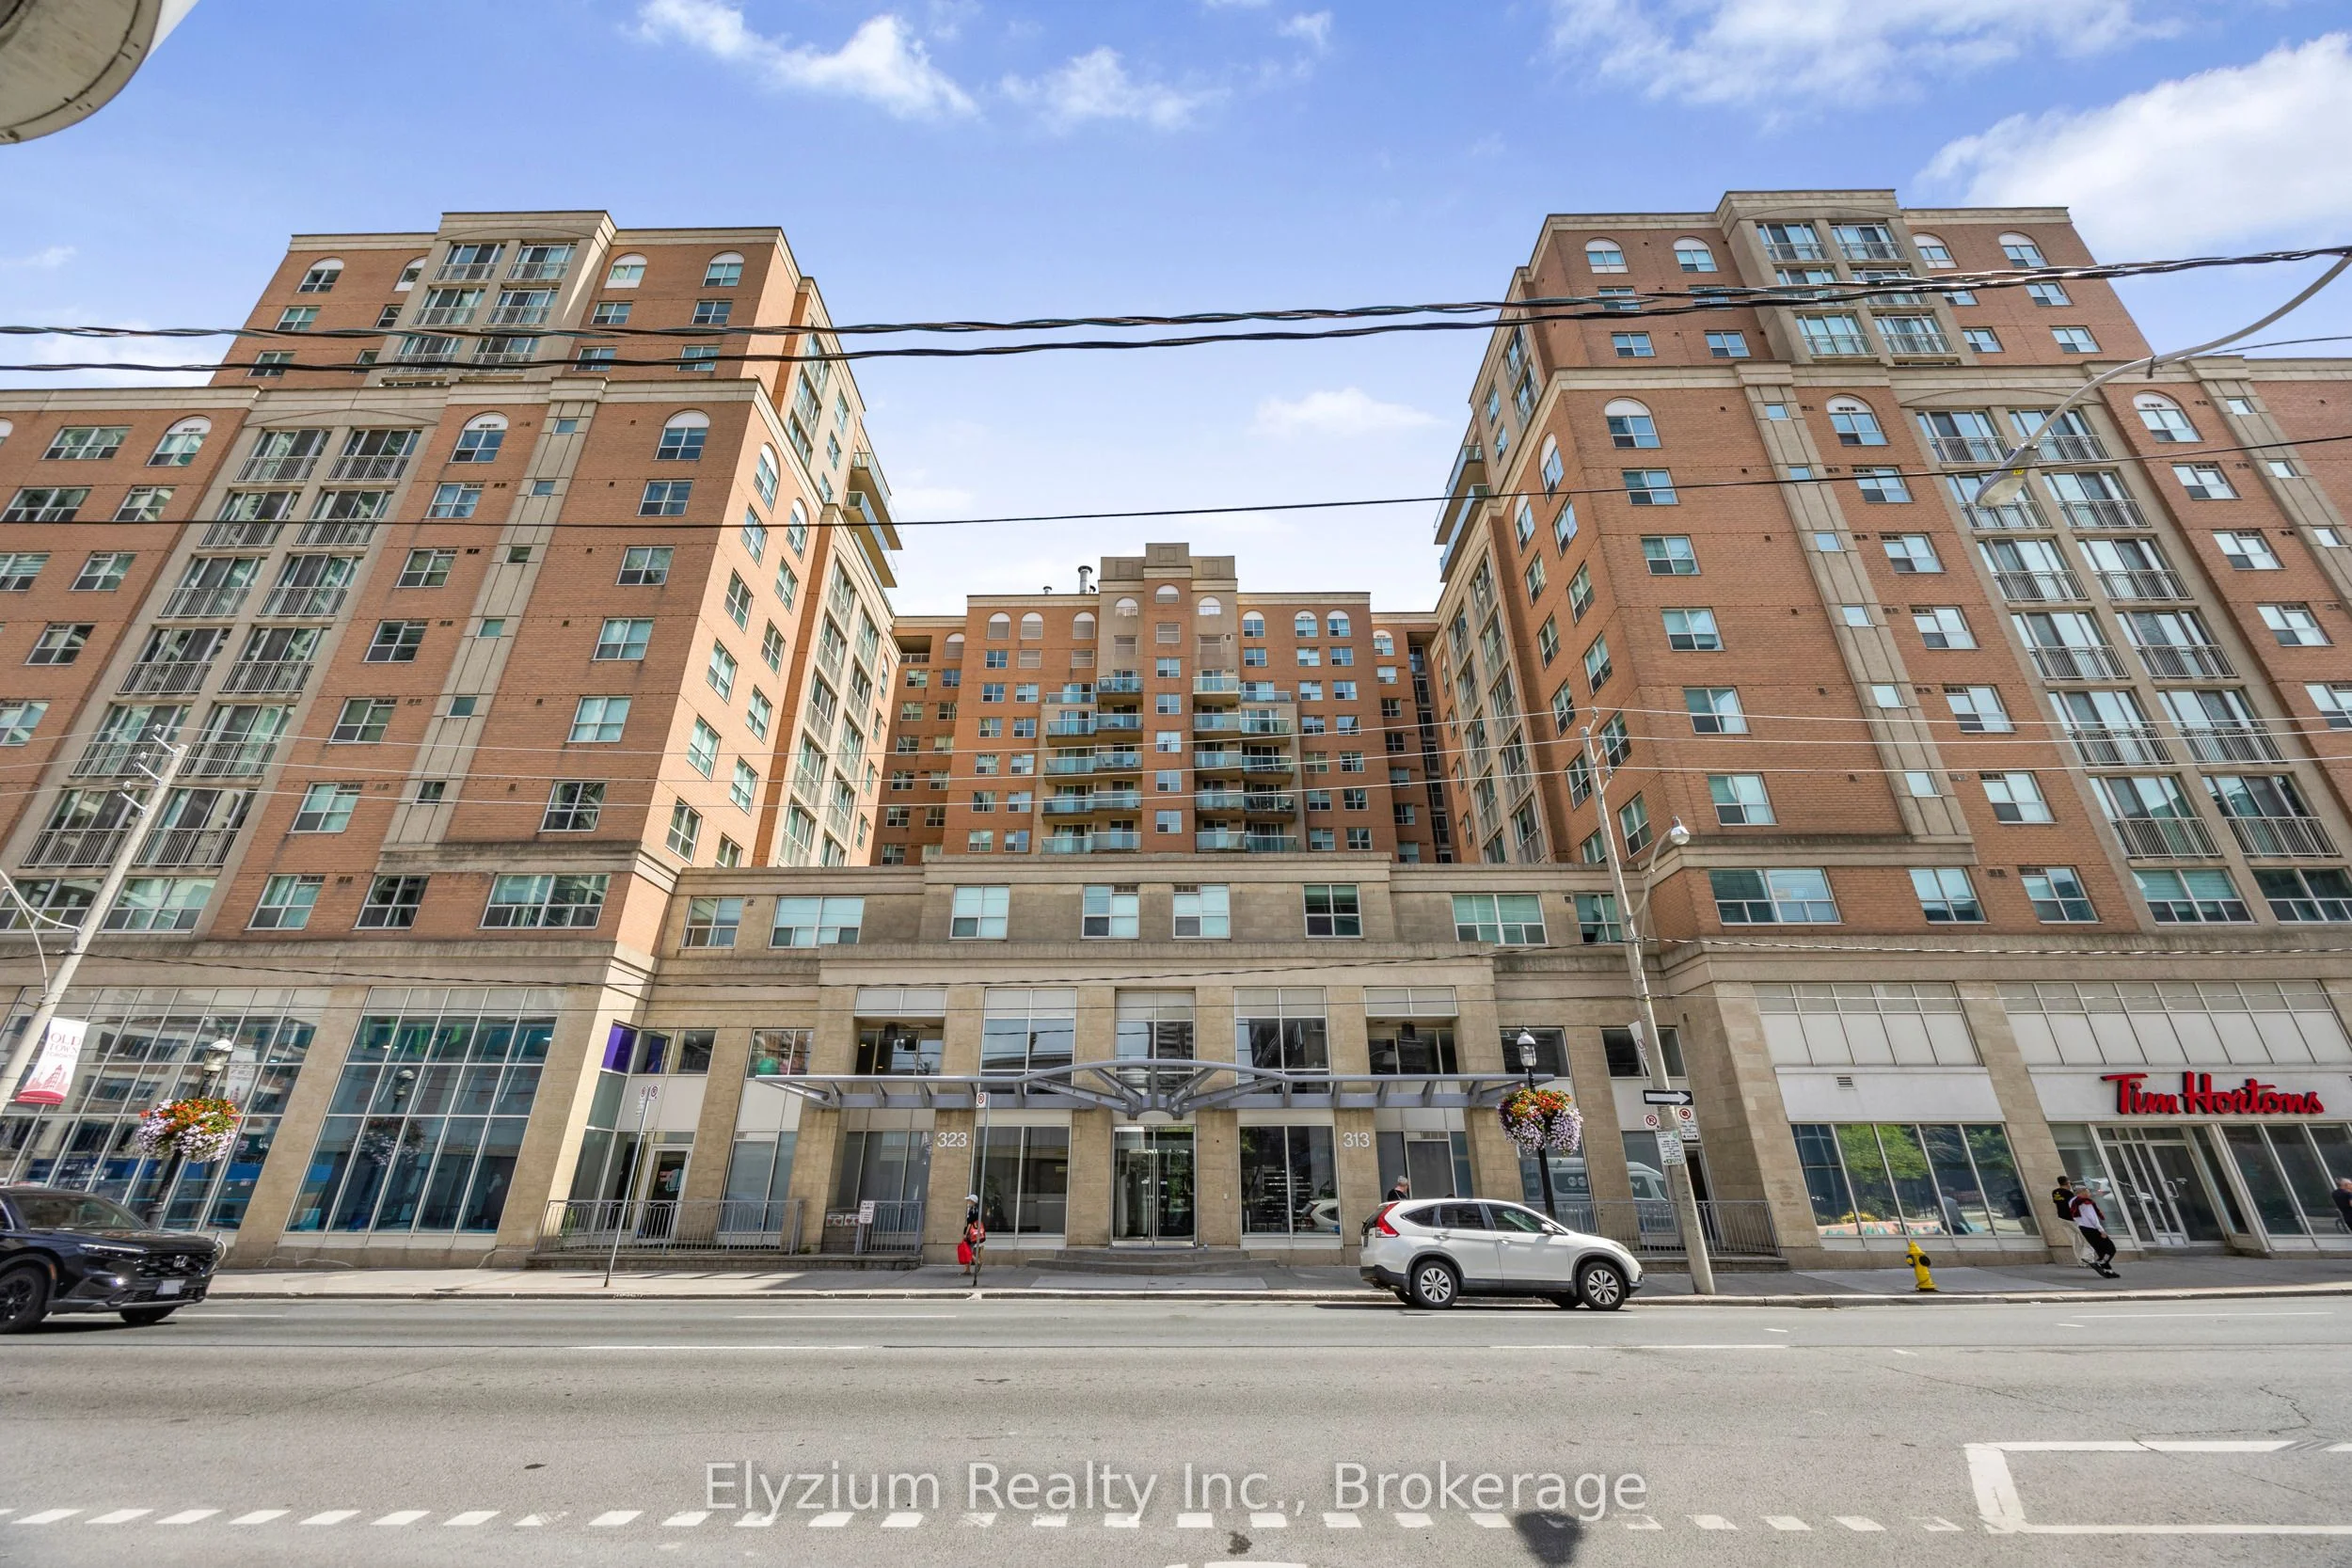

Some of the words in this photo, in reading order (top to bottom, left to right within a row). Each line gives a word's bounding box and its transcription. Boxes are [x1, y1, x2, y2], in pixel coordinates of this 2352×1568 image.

[51, 1032, 82, 1046] OLD
[2100, 1072, 2181, 1115] Tim
[2178, 1070, 2325, 1115] Hortons
[937, 1132, 967, 1148] 323
[1343, 1132, 1370, 1148] 313
